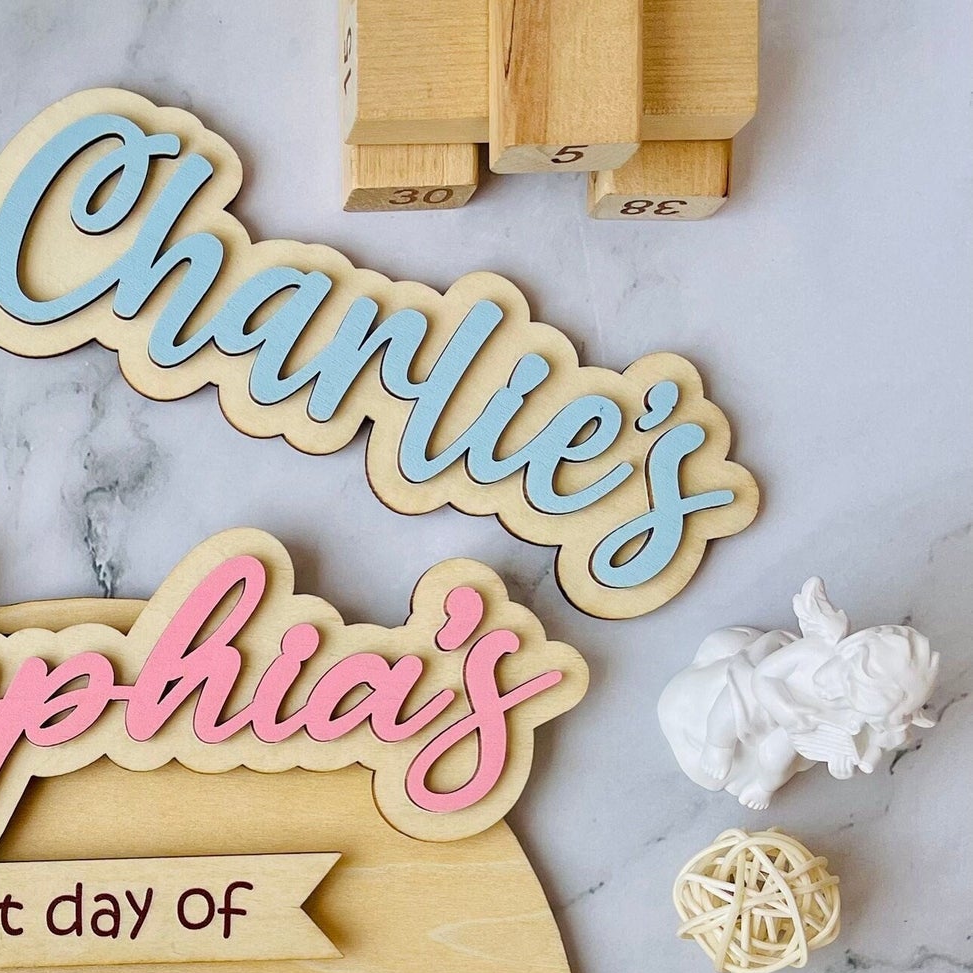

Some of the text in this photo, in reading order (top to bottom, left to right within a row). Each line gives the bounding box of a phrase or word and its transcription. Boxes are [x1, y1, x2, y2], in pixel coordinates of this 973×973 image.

[550, 144, 589, 165] 5
[388, 187, 454, 206] 30
[619, 198, 688, 217] 38
[46, 882, 154, 940] day
